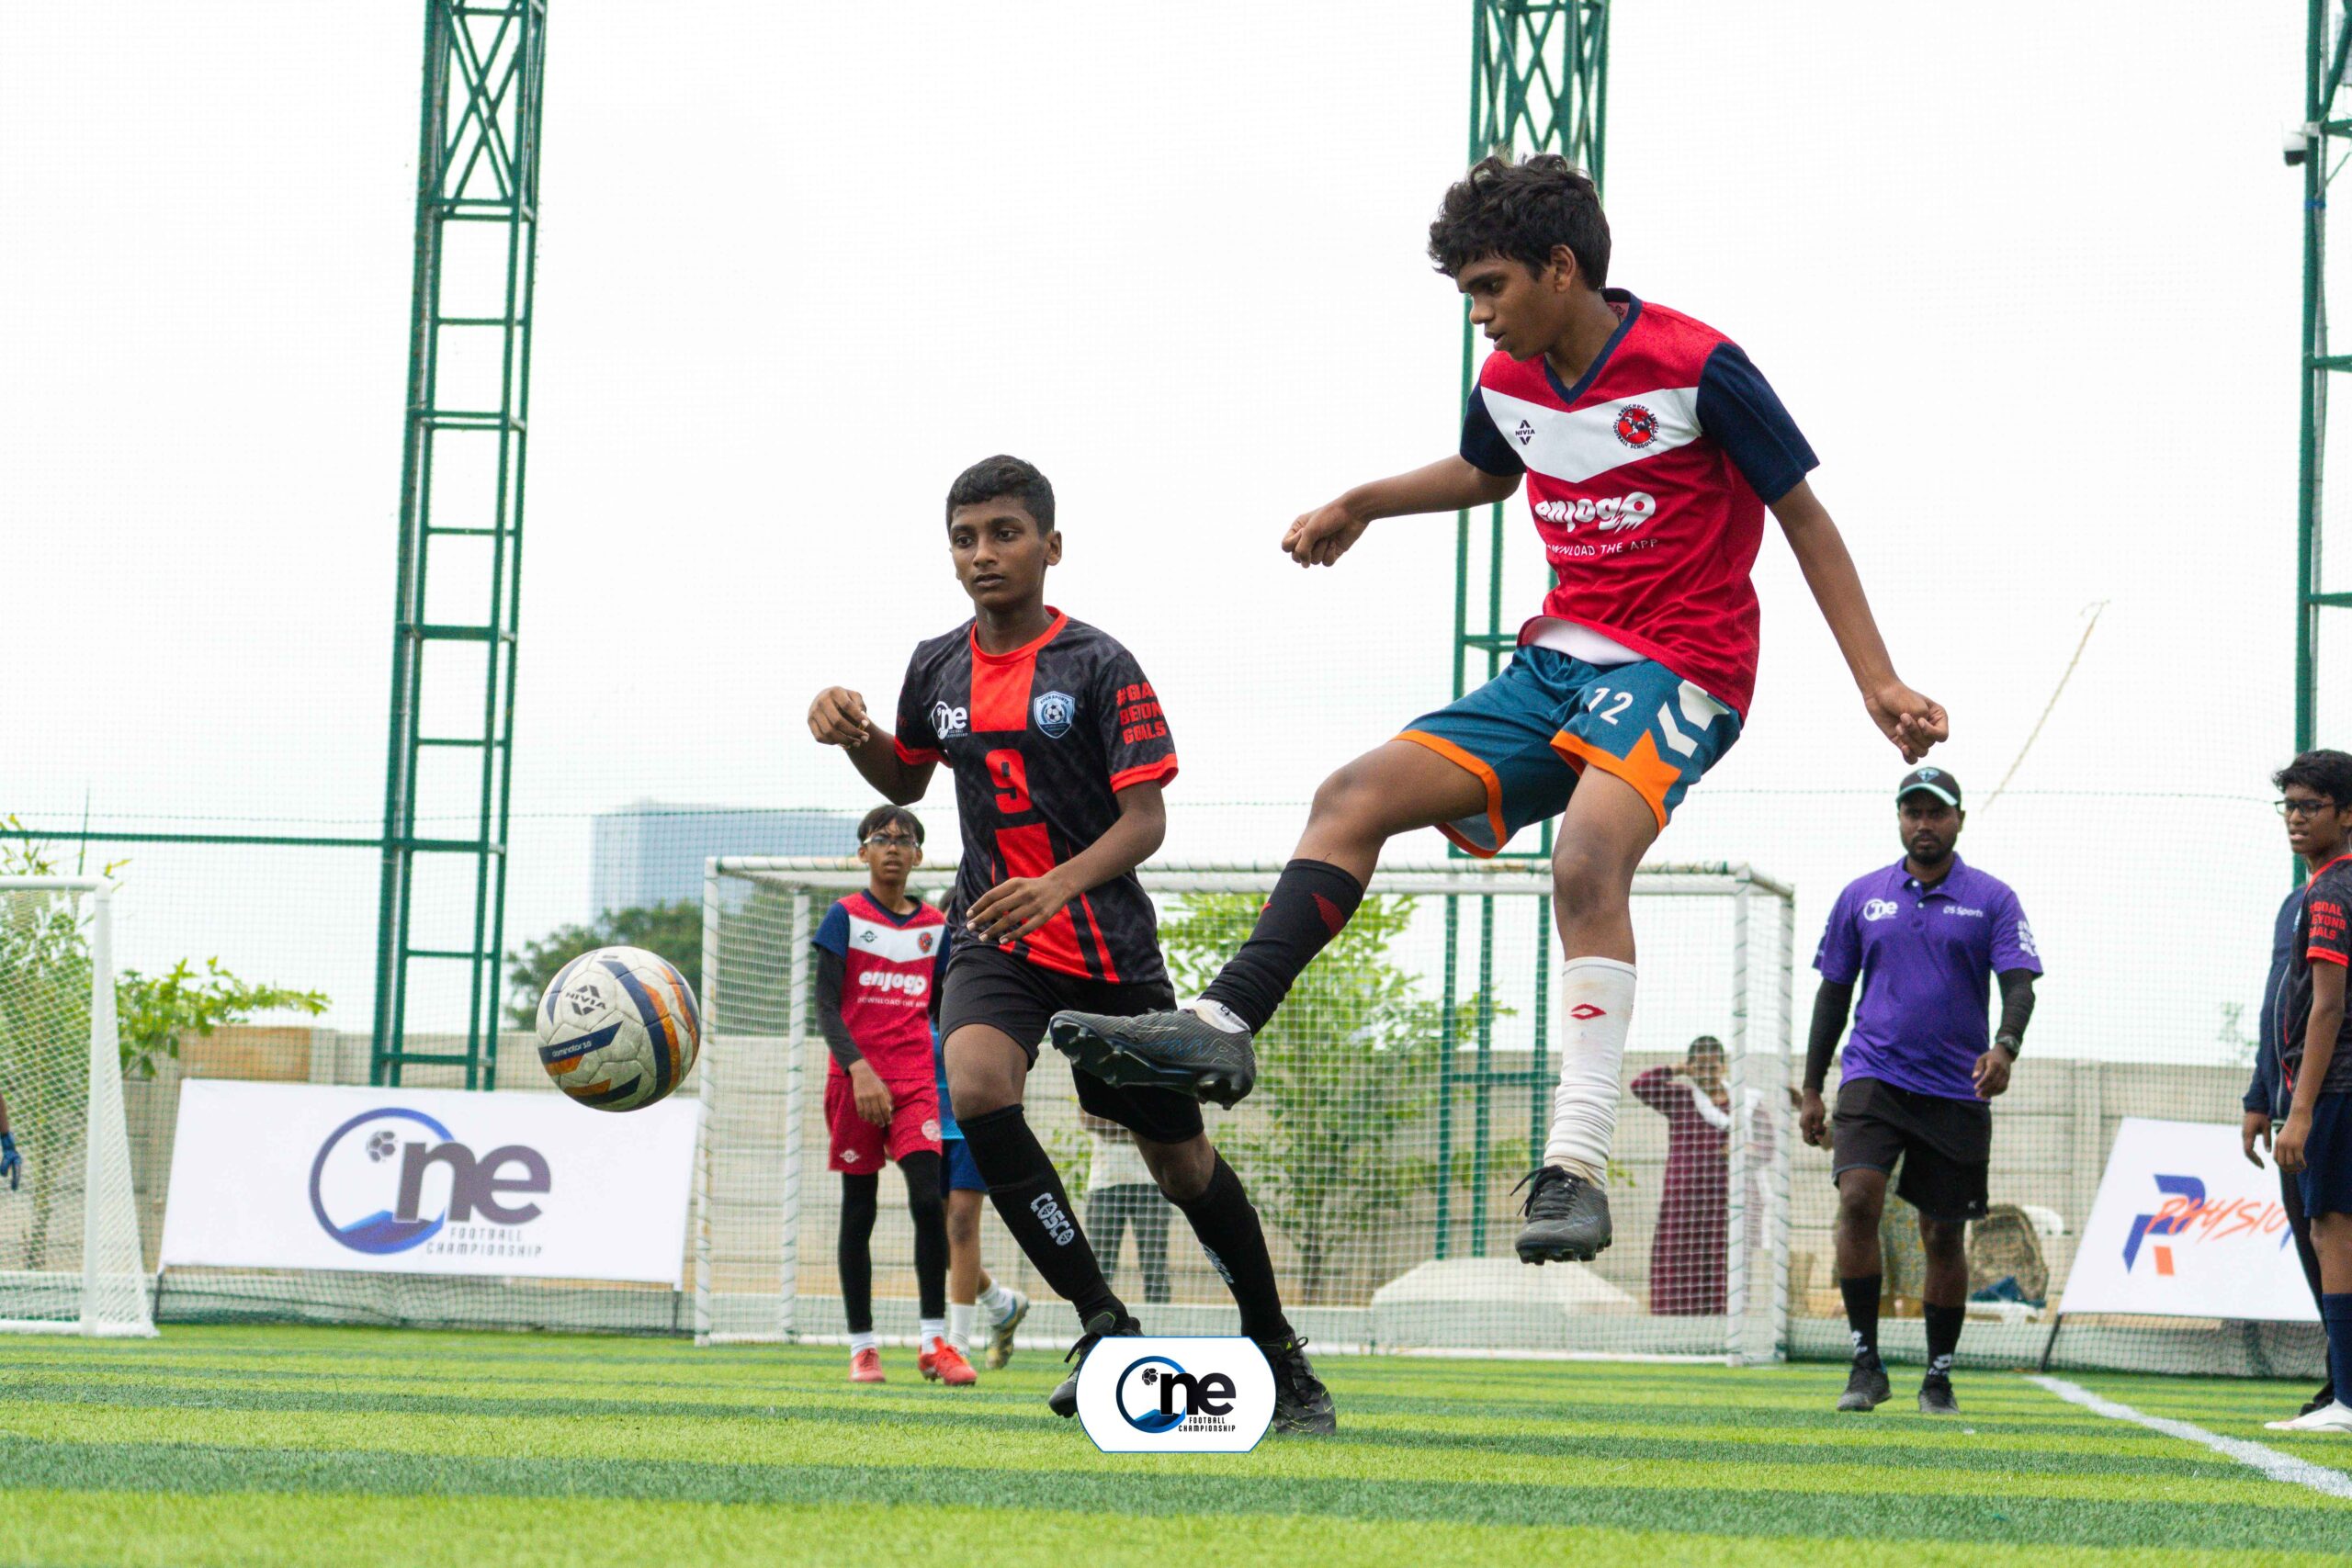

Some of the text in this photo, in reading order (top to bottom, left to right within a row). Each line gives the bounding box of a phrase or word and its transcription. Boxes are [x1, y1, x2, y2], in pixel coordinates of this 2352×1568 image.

[1600, 542, 1623, 554] THE
[1631, 539, 1657, 550] APP
[1589, 687, 1633, 726] 12
[1123, 720, 1167, 745] GOALS
[985, 748, 1033, 815] 9
[1957, 906, 1984, 918] Sports
[566, 992, 605, 1010] NIVIA
[1030, 1192, 1075, 1246] COSCO
[449, 1226, 523, 1242] FOOTBALL
[426, 1242, 543, 1258] CHAMPIONSHIP
